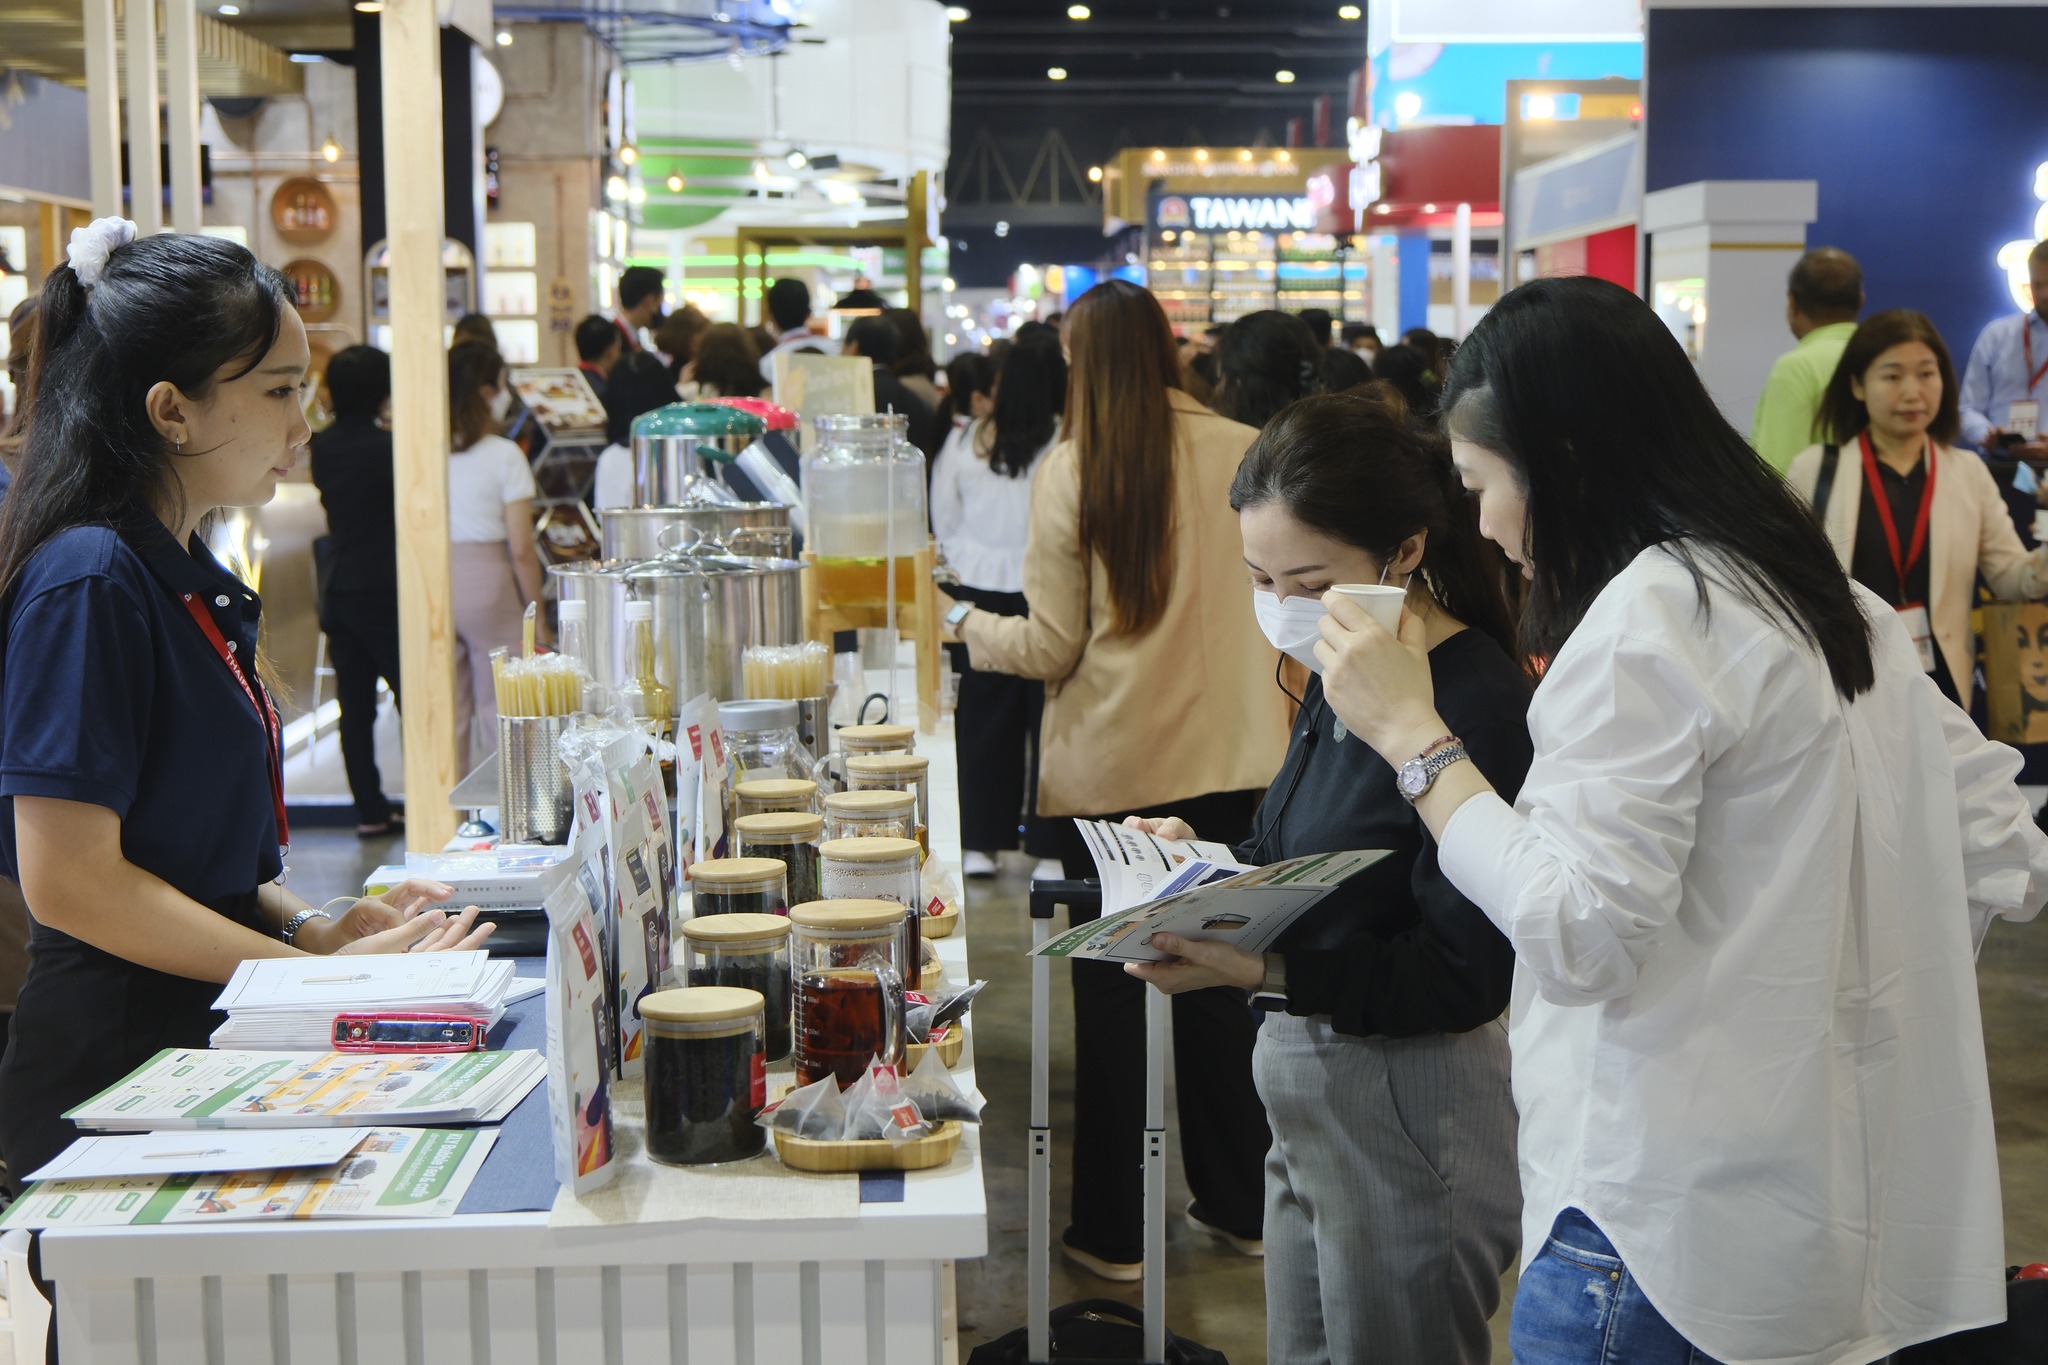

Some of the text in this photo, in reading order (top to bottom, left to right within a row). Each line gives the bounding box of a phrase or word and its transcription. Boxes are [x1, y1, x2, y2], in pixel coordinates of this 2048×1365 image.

[226, 650, 256, 703] THAIFEX
[1052, 935, 1076, 951] KLY
[444, 1133, 464, 1146] KLY
[430, 1144, 457, 1166] Bubble
[422, 1165, 444, 1178] Tea
